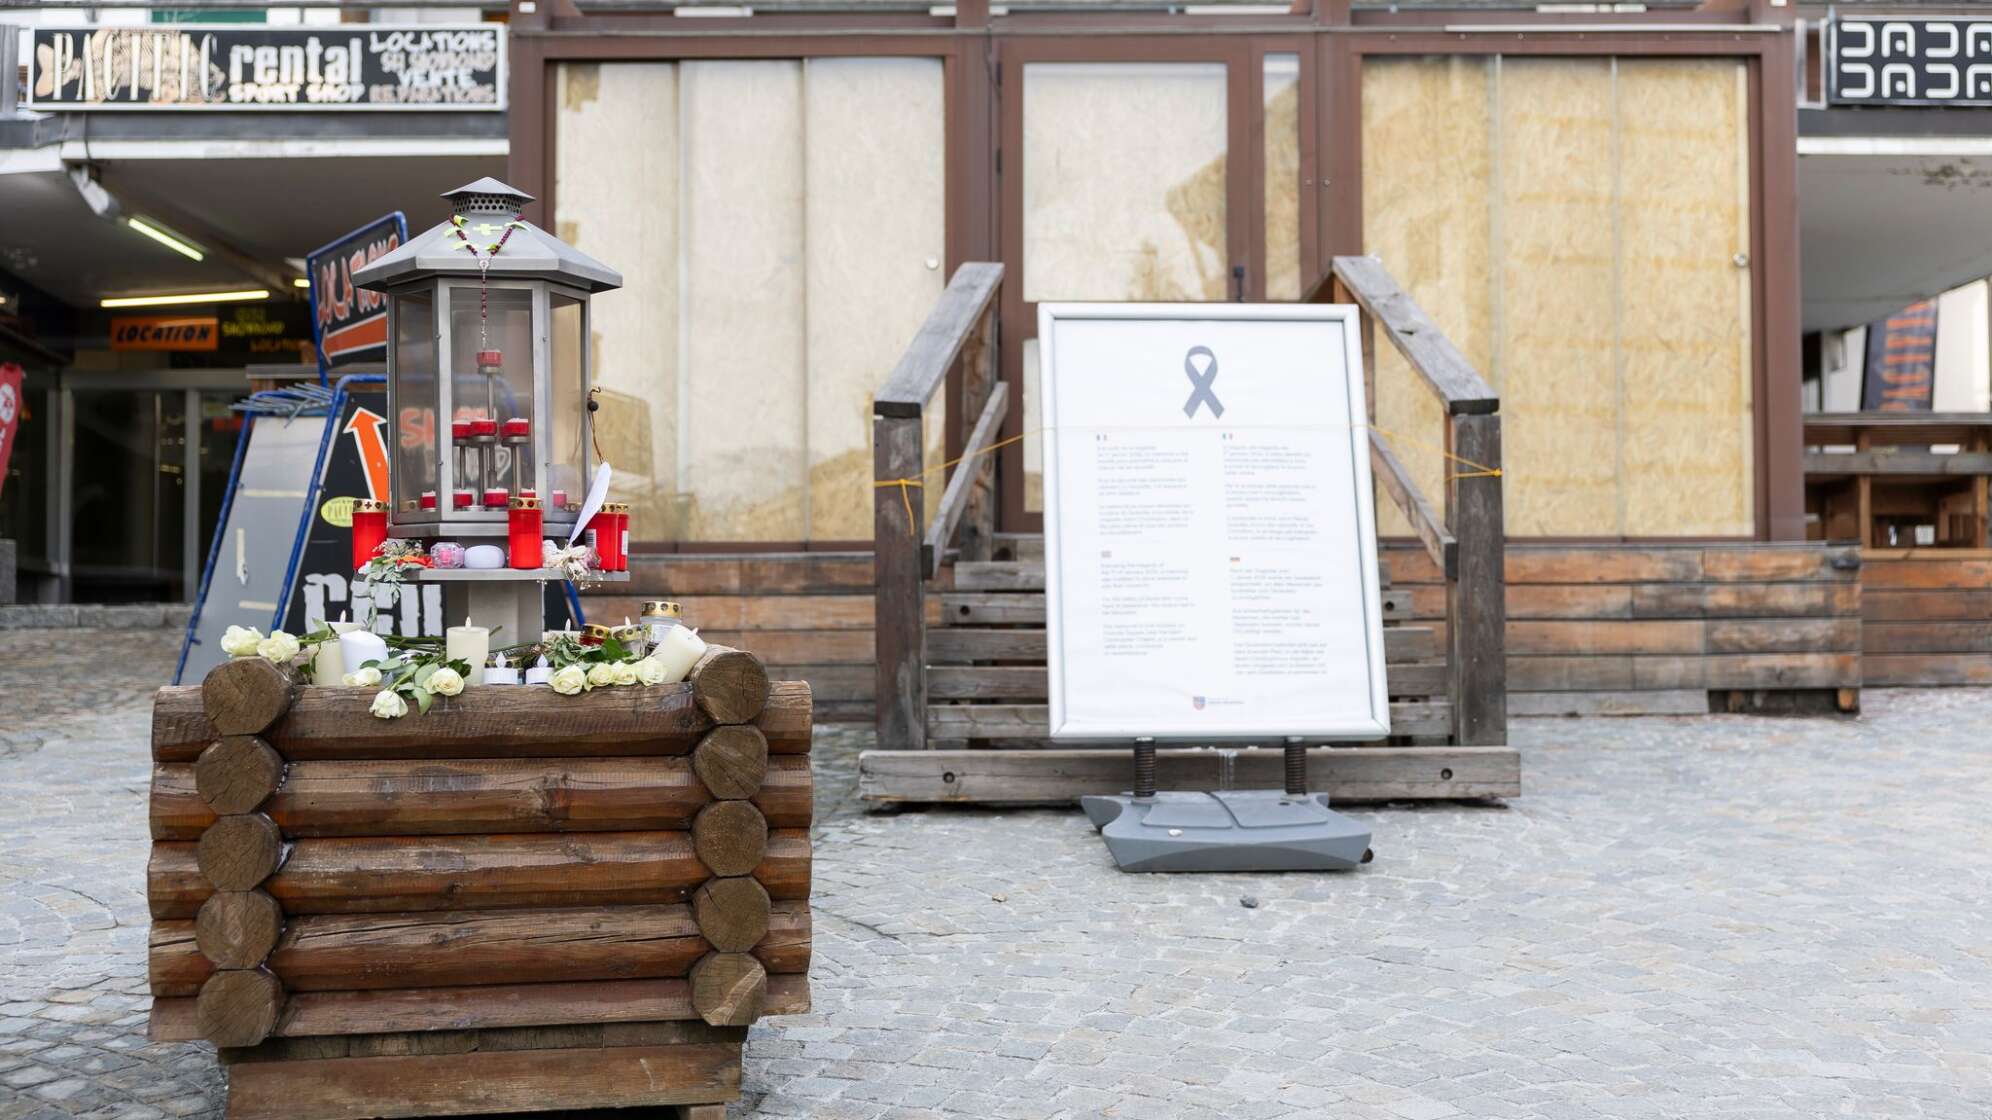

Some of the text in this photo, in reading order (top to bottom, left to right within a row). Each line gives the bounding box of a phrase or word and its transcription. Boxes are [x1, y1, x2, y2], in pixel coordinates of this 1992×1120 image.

[369, 31, 496, 53] LOCATIONS
[229, 37, 362, 85] rental
[397, 68, 477, 88] VENTE
[228, 82, 365, 102] SPORT SHOP
[116, 325, 210, 343] LOCATION
